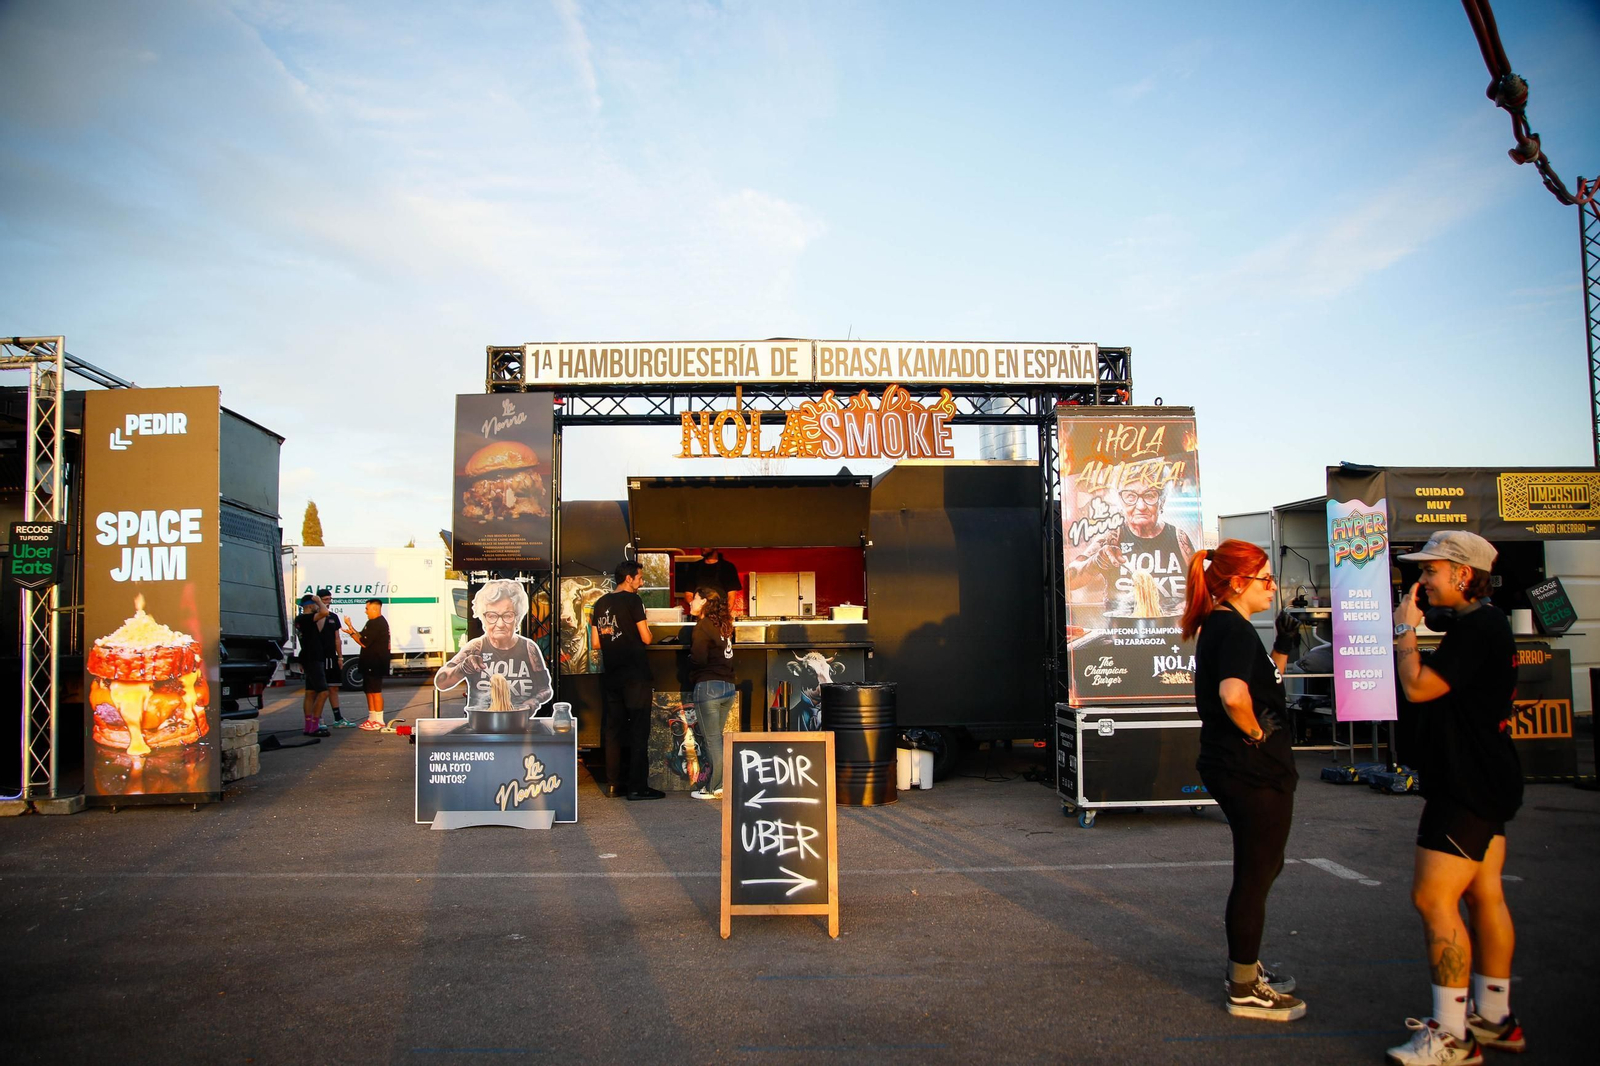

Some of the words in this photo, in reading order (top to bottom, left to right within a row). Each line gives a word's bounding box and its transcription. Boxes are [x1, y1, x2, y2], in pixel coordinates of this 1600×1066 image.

[559, 344, 759, 379] HAMBURGUESERÍA
[771, 347, 798, 376] DE
[820, 347, 892, 377] BRASA
[899, 348, 989, 378] KAMADO
[996, 349, 1018, 378] EN
[1025, 345, 1095, 379] ESPAÑA
[126, 413, 187, 435] PEDIR
[482, 412, 527, 438] Nonna
[672, 407, 817, 459] NOLA
[820, 412, 954, 458] SMOKE
[1097, 424, 1165, 457] ¡HOLA
[1415, 487, 1464, 496] CUIDADO
[1426, 501, 1451, 509] MUY
[1415, 513, 1467, 523] CALIENTE
[15, 525, 54, 534] RECOGE
[96, 509, 202, 545] SPACE
[1069, 512, 1124, 546] Nonna
[1332, 513, 1387, 541] HYPER
[1535, 524, 1556, 533] SABOR
[13, 544, 53, 559] Uber
[1334, 534, 1387, 568] POP
[11, 559, 53, 575] Eats
[110, 546, 187, 581] JAM
[1120, 550, 1182, 575] NOLA
[1348, 589, 1372, 598] PAN
[1531, 580, 1557, 596] RECOGE
[1341, 598, 1379, 609] RECIÉN
[1536, 596, 1565, 614] Uber
[1343, 612, 1380, 621] HECHO
[1542, 607, 1572, 626] Eats
[1114, 638, 1124, 646] EN
[1125, 637, 1166, 645] ZARAGOZA
[1348, 635, 1377, 644] VACA
[1339, 646, 1387, 655] GALLEGA
[481, 659, 530, 678] NOLA
[1098, 656, 1114, 669] The
[1152, 655, 1196, 677] NOLA
[1084, 665, 1128, 677] Champions
[1345, 669, 1383, 679] BACON
[1092, 674, 1122, 687] Burger
[1352, 681, 1376, 690] POP
[429, 752, 451, 762] ¿NOS
[452, 751, 495, 761] HACEMOS
[429, 763, 447, 773] UNA
[450, 762, 471, 773] FOTO
[523, 755, 545, 781] La
[739, 748, 818, 787] PEDIR
[429, 774, 467, 784] JUNTOS?
[495, 773, 561, 811] Nonna
[741, 819, 820, 860] UBER
